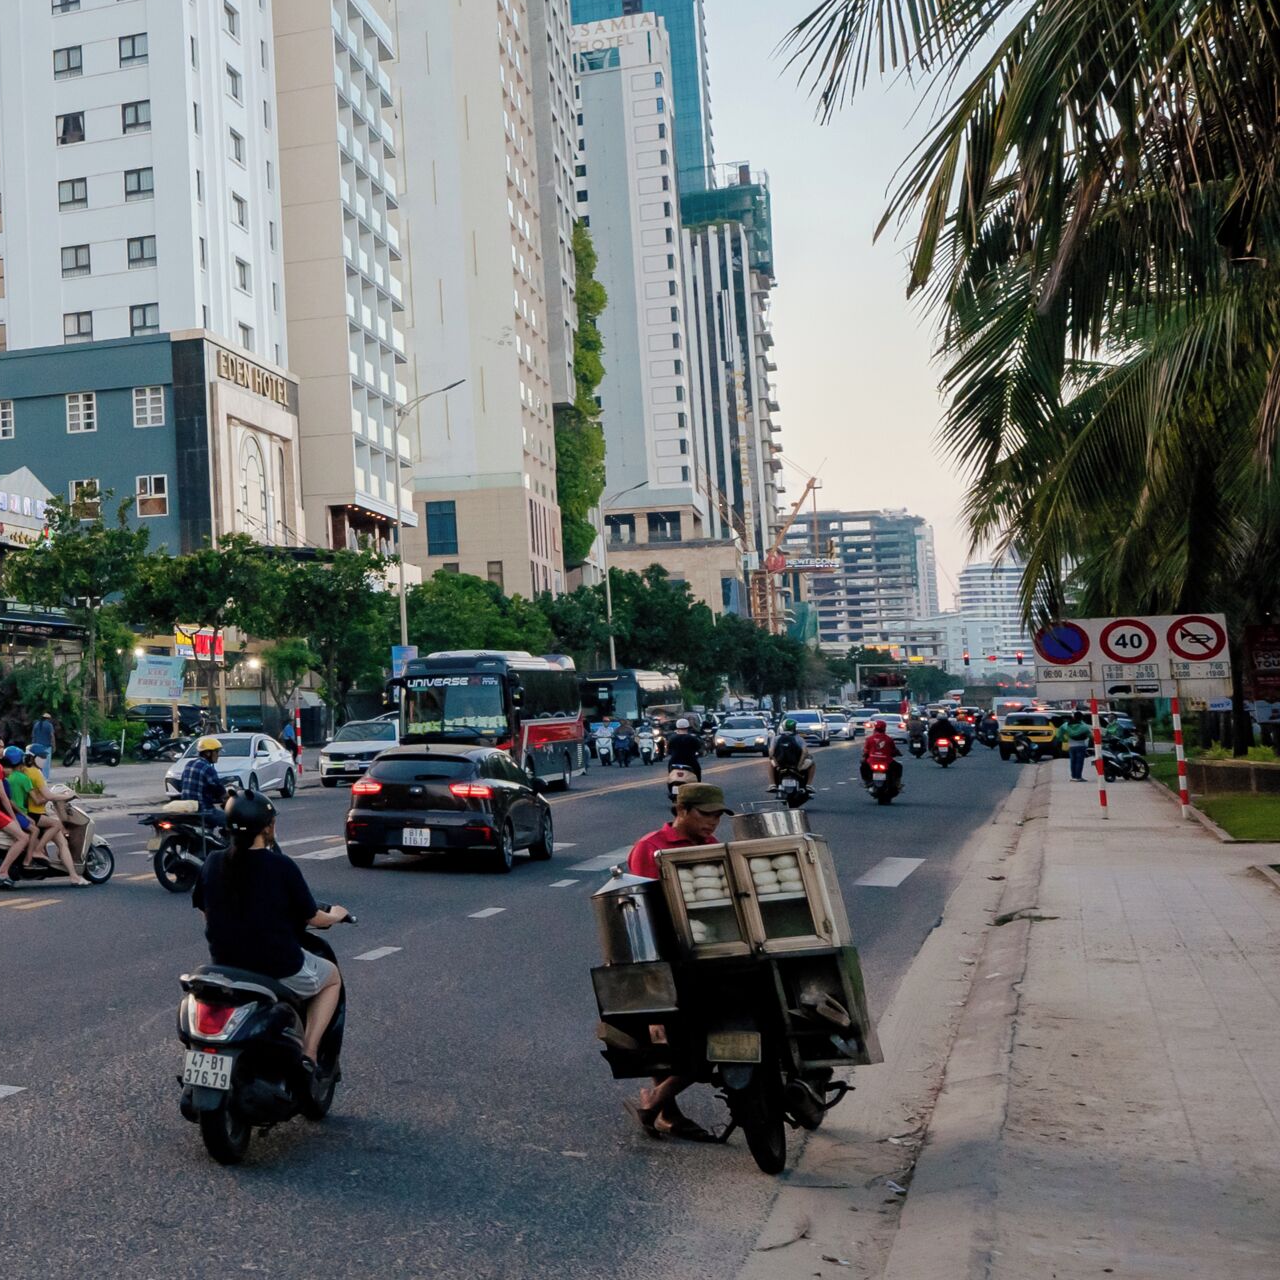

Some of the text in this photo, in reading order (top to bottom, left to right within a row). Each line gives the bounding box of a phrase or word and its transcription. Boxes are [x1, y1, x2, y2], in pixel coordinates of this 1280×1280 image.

[217, 350, 289, 407] EDEN HOTEL
[1114, 633, 1143, 649] 40
[407, 677, 469, 688] UNIVERSE
[191, 1053, 224, 1071] 47-B1
[184, 1068, 228, 1088] 376.79
